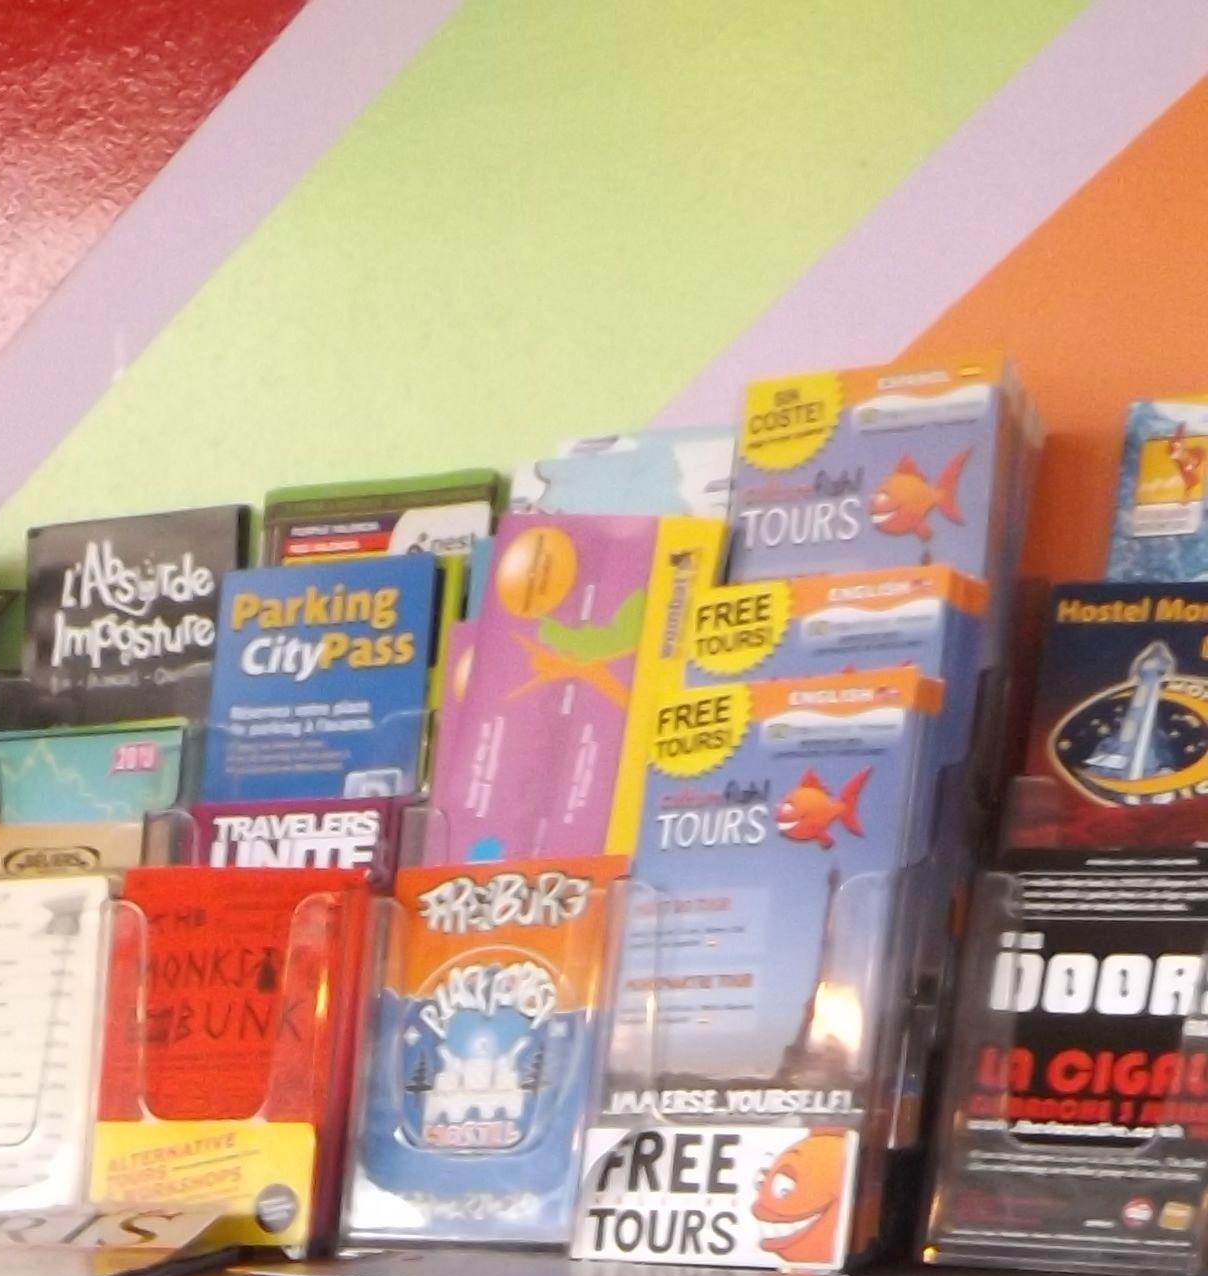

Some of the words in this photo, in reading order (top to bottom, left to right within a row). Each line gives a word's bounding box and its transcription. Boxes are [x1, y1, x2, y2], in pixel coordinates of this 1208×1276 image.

[739, 497, 861, 548] TOURS
[231, 584, 400, 632] Parking
[695, 592, 773, 634] FREE
[1056, 596, 1149, 624] Hostel
[50, 611, 216, 670] Imposture
[241, 630, 416, 682] CityPass
[656, 695, 733, 735] FREE
[212, 809, 381, 843] TRAVELERS
[656, 805, 769, 849] TOURS
[990, 952, 1208, 1017] DOOR
[976, 1047, 1035, 1092] LA
[596, 1130, 742, 1195] FREE
[588, 1207, 739, 1256] TOURS
